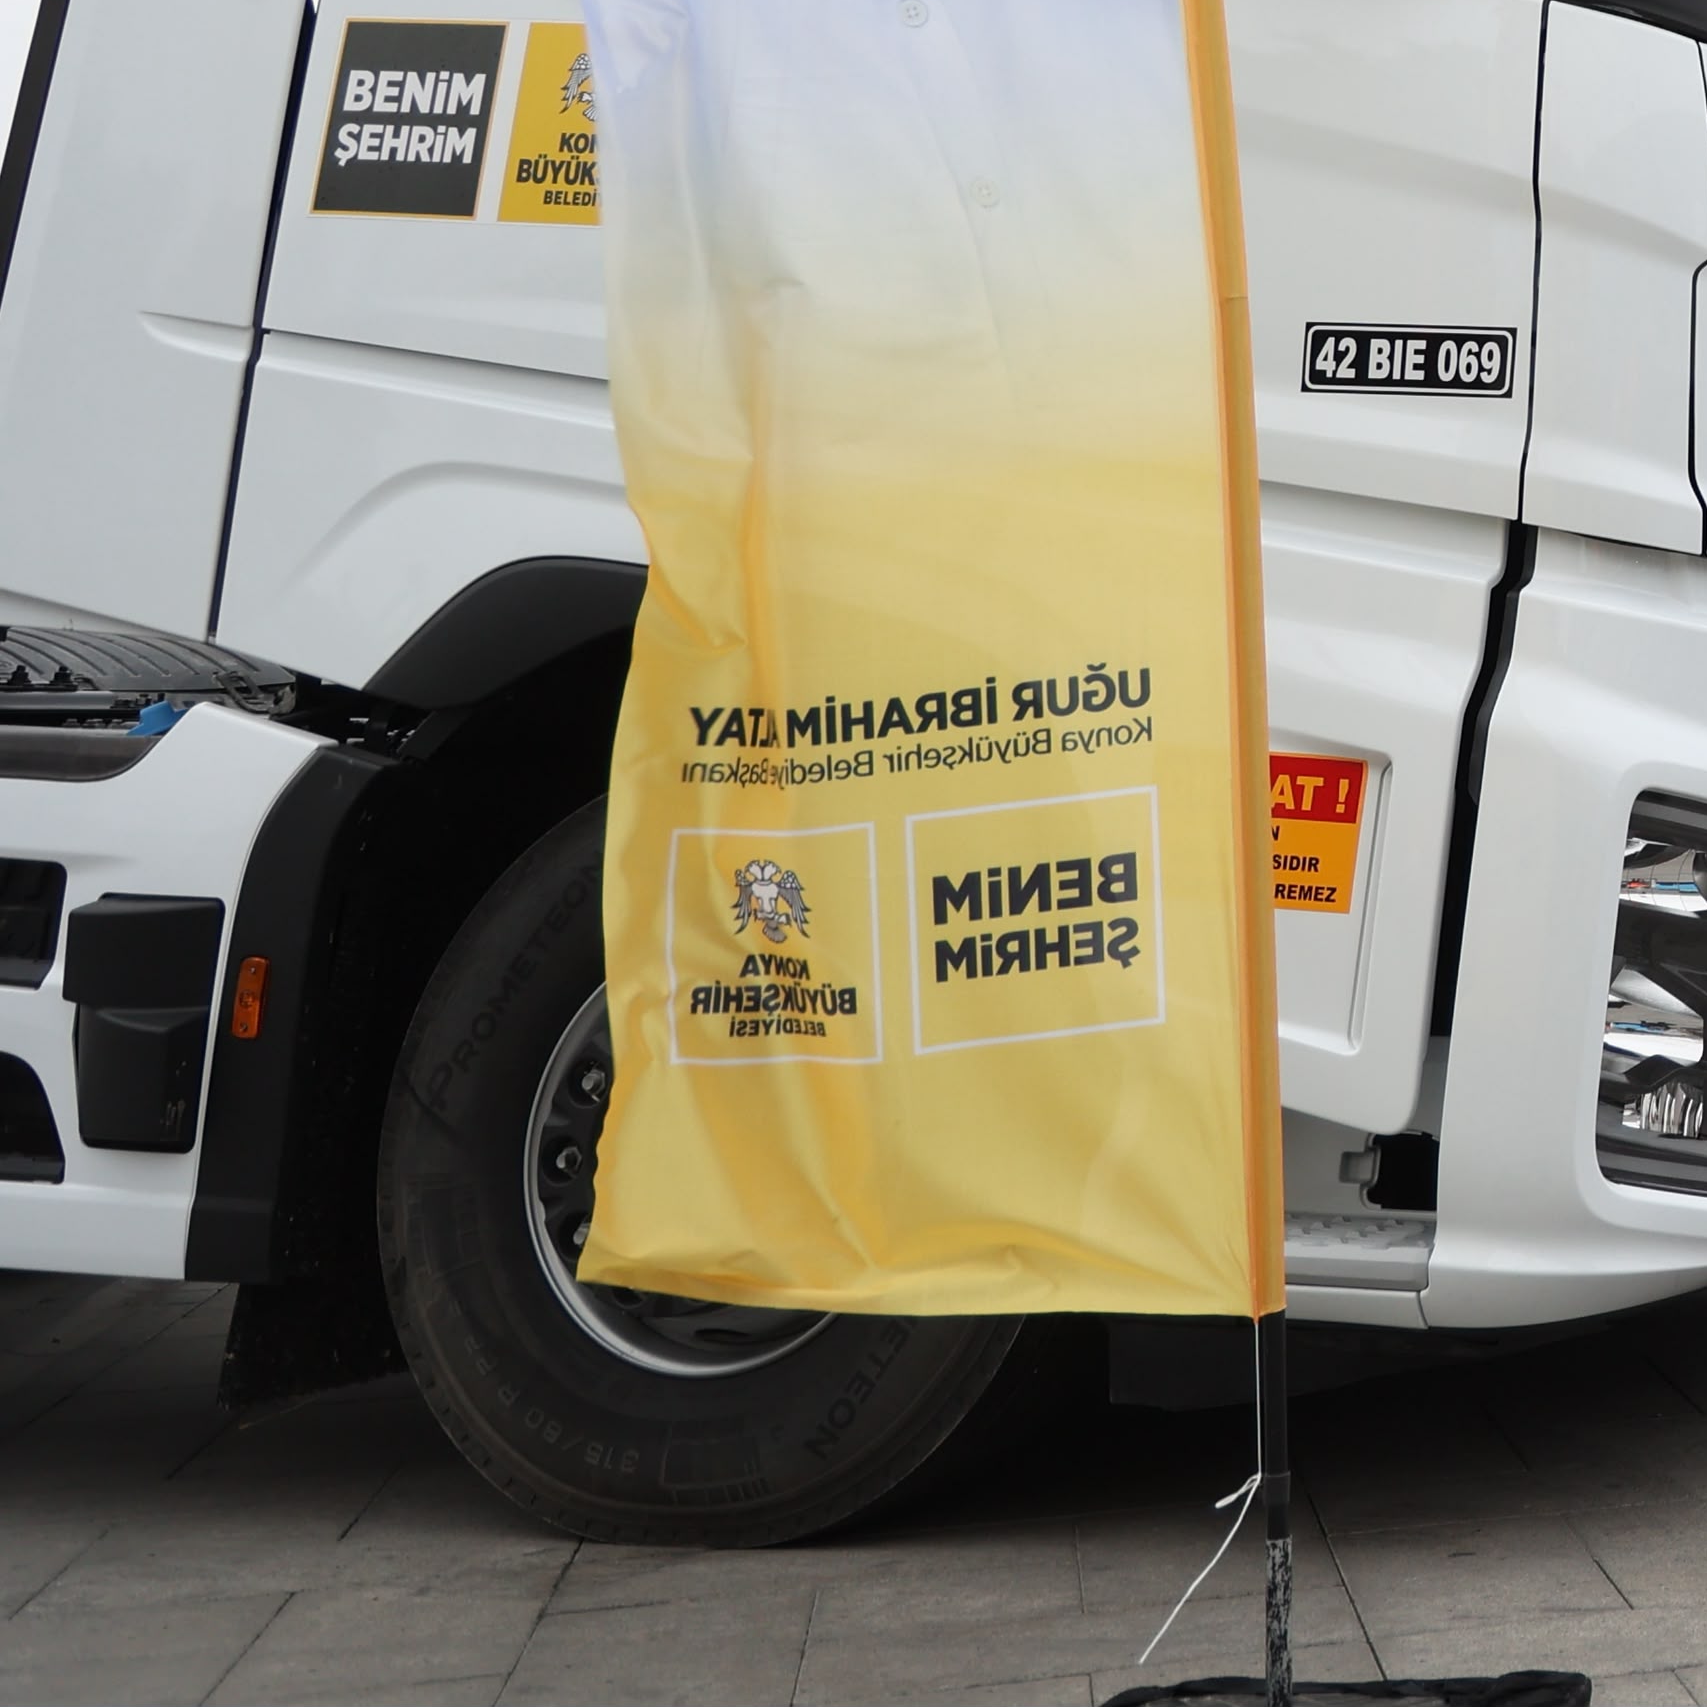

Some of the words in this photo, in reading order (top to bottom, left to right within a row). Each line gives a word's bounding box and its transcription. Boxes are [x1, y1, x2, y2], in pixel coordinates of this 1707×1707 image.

[515, 154, 600, 186] BÜYÜK
[543, 188, 598, 207] BELEDİ
[1315, 335, 1358, 379] 42
[1367, 338, 1428, 381] BIE
[1437, 339, 1502, 384] 069
